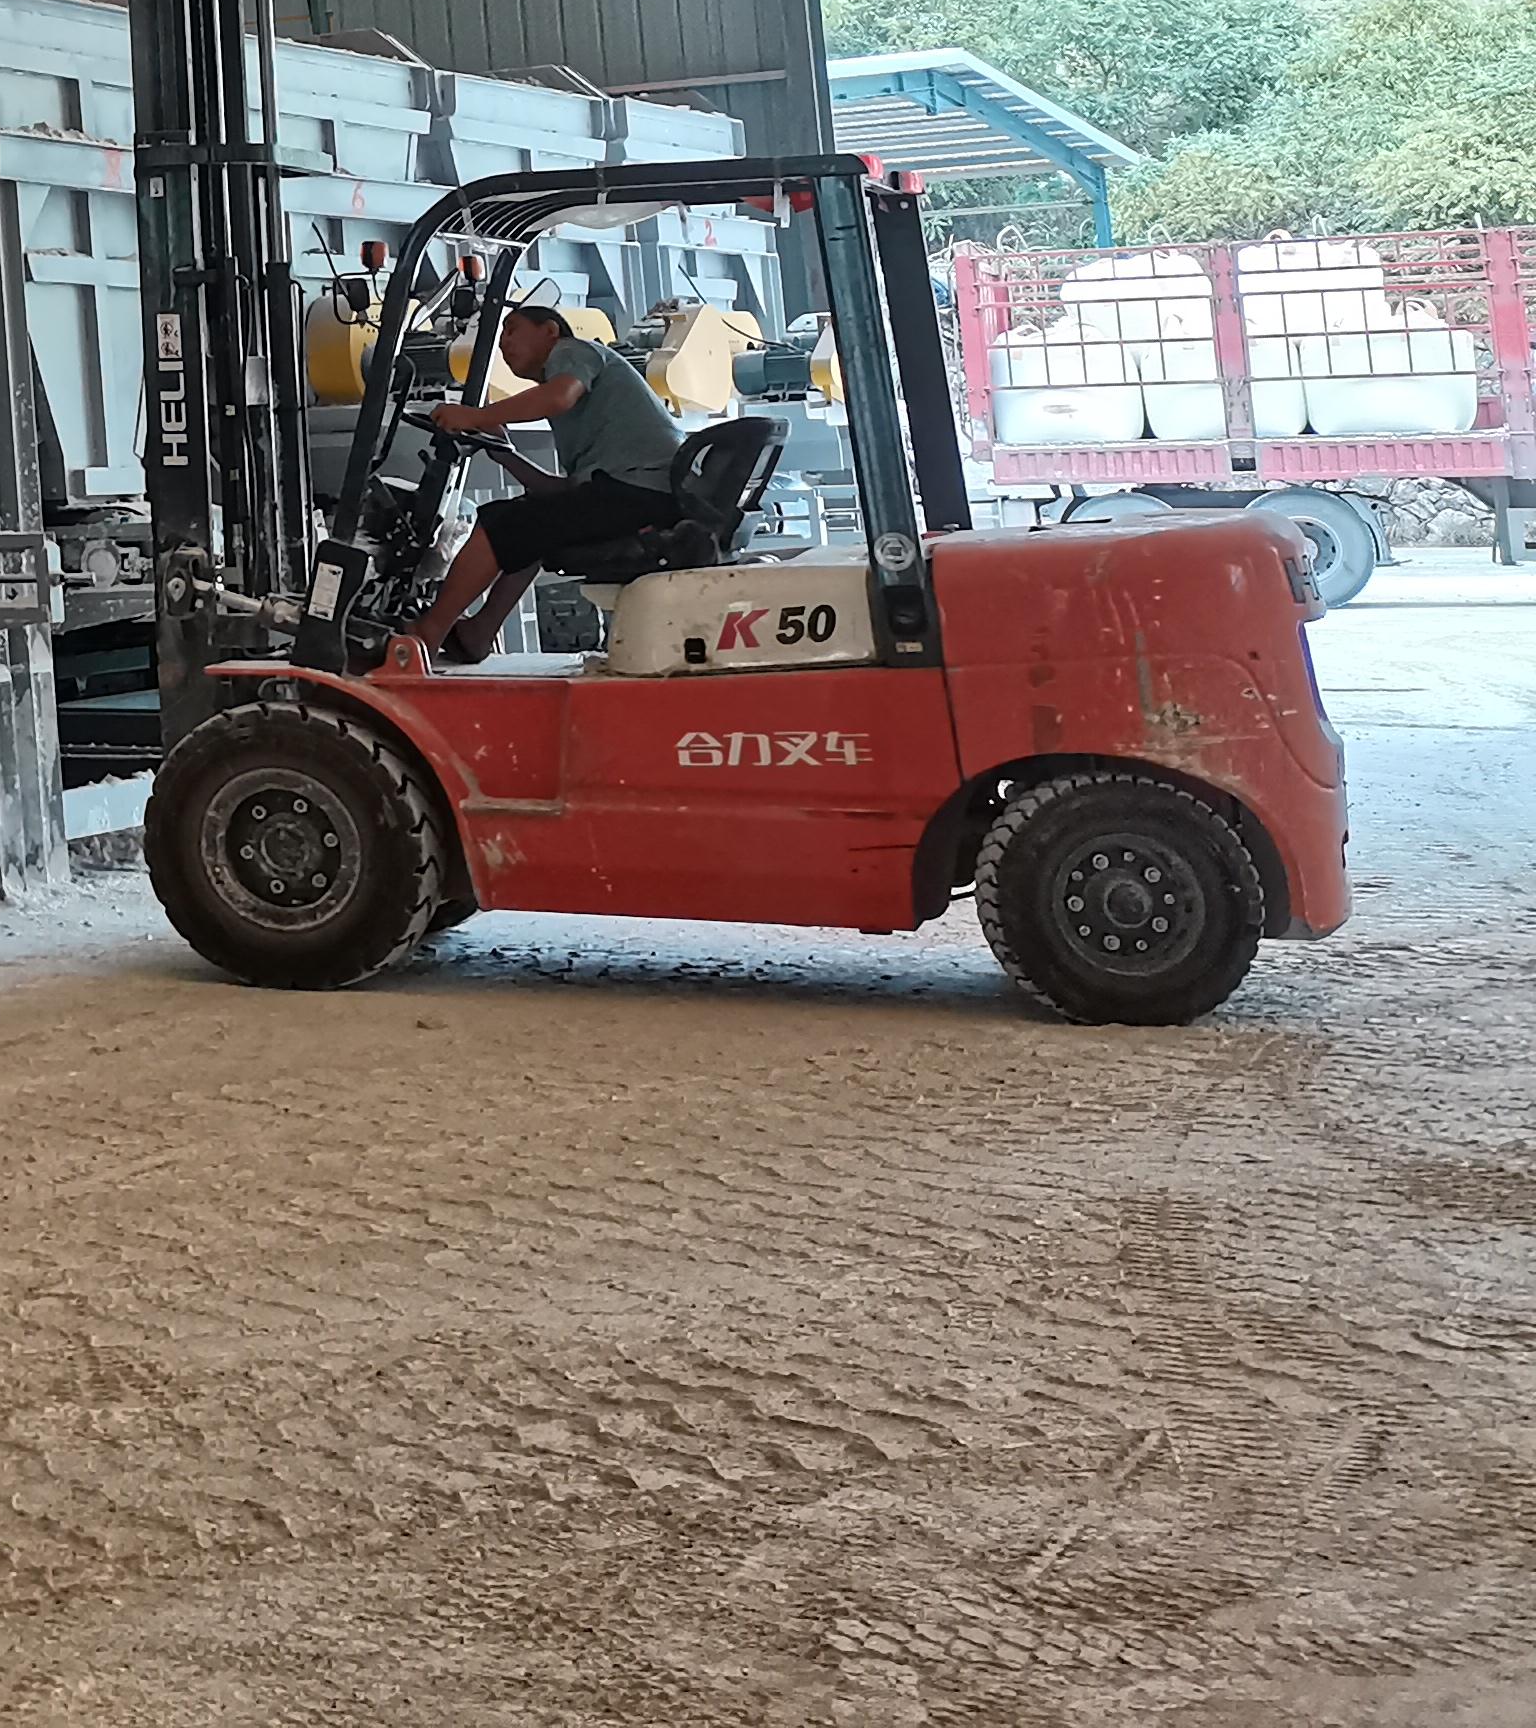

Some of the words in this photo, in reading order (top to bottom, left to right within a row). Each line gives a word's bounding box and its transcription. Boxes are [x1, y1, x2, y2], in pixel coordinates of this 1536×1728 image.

[351, 181, 366, 216] 6
[703, 218, 718, 247] 2
[157, 360, 189, 466] HELI
[775, 604, 837, 645] 50
[673, 731, 875, 766] 合力叉车
